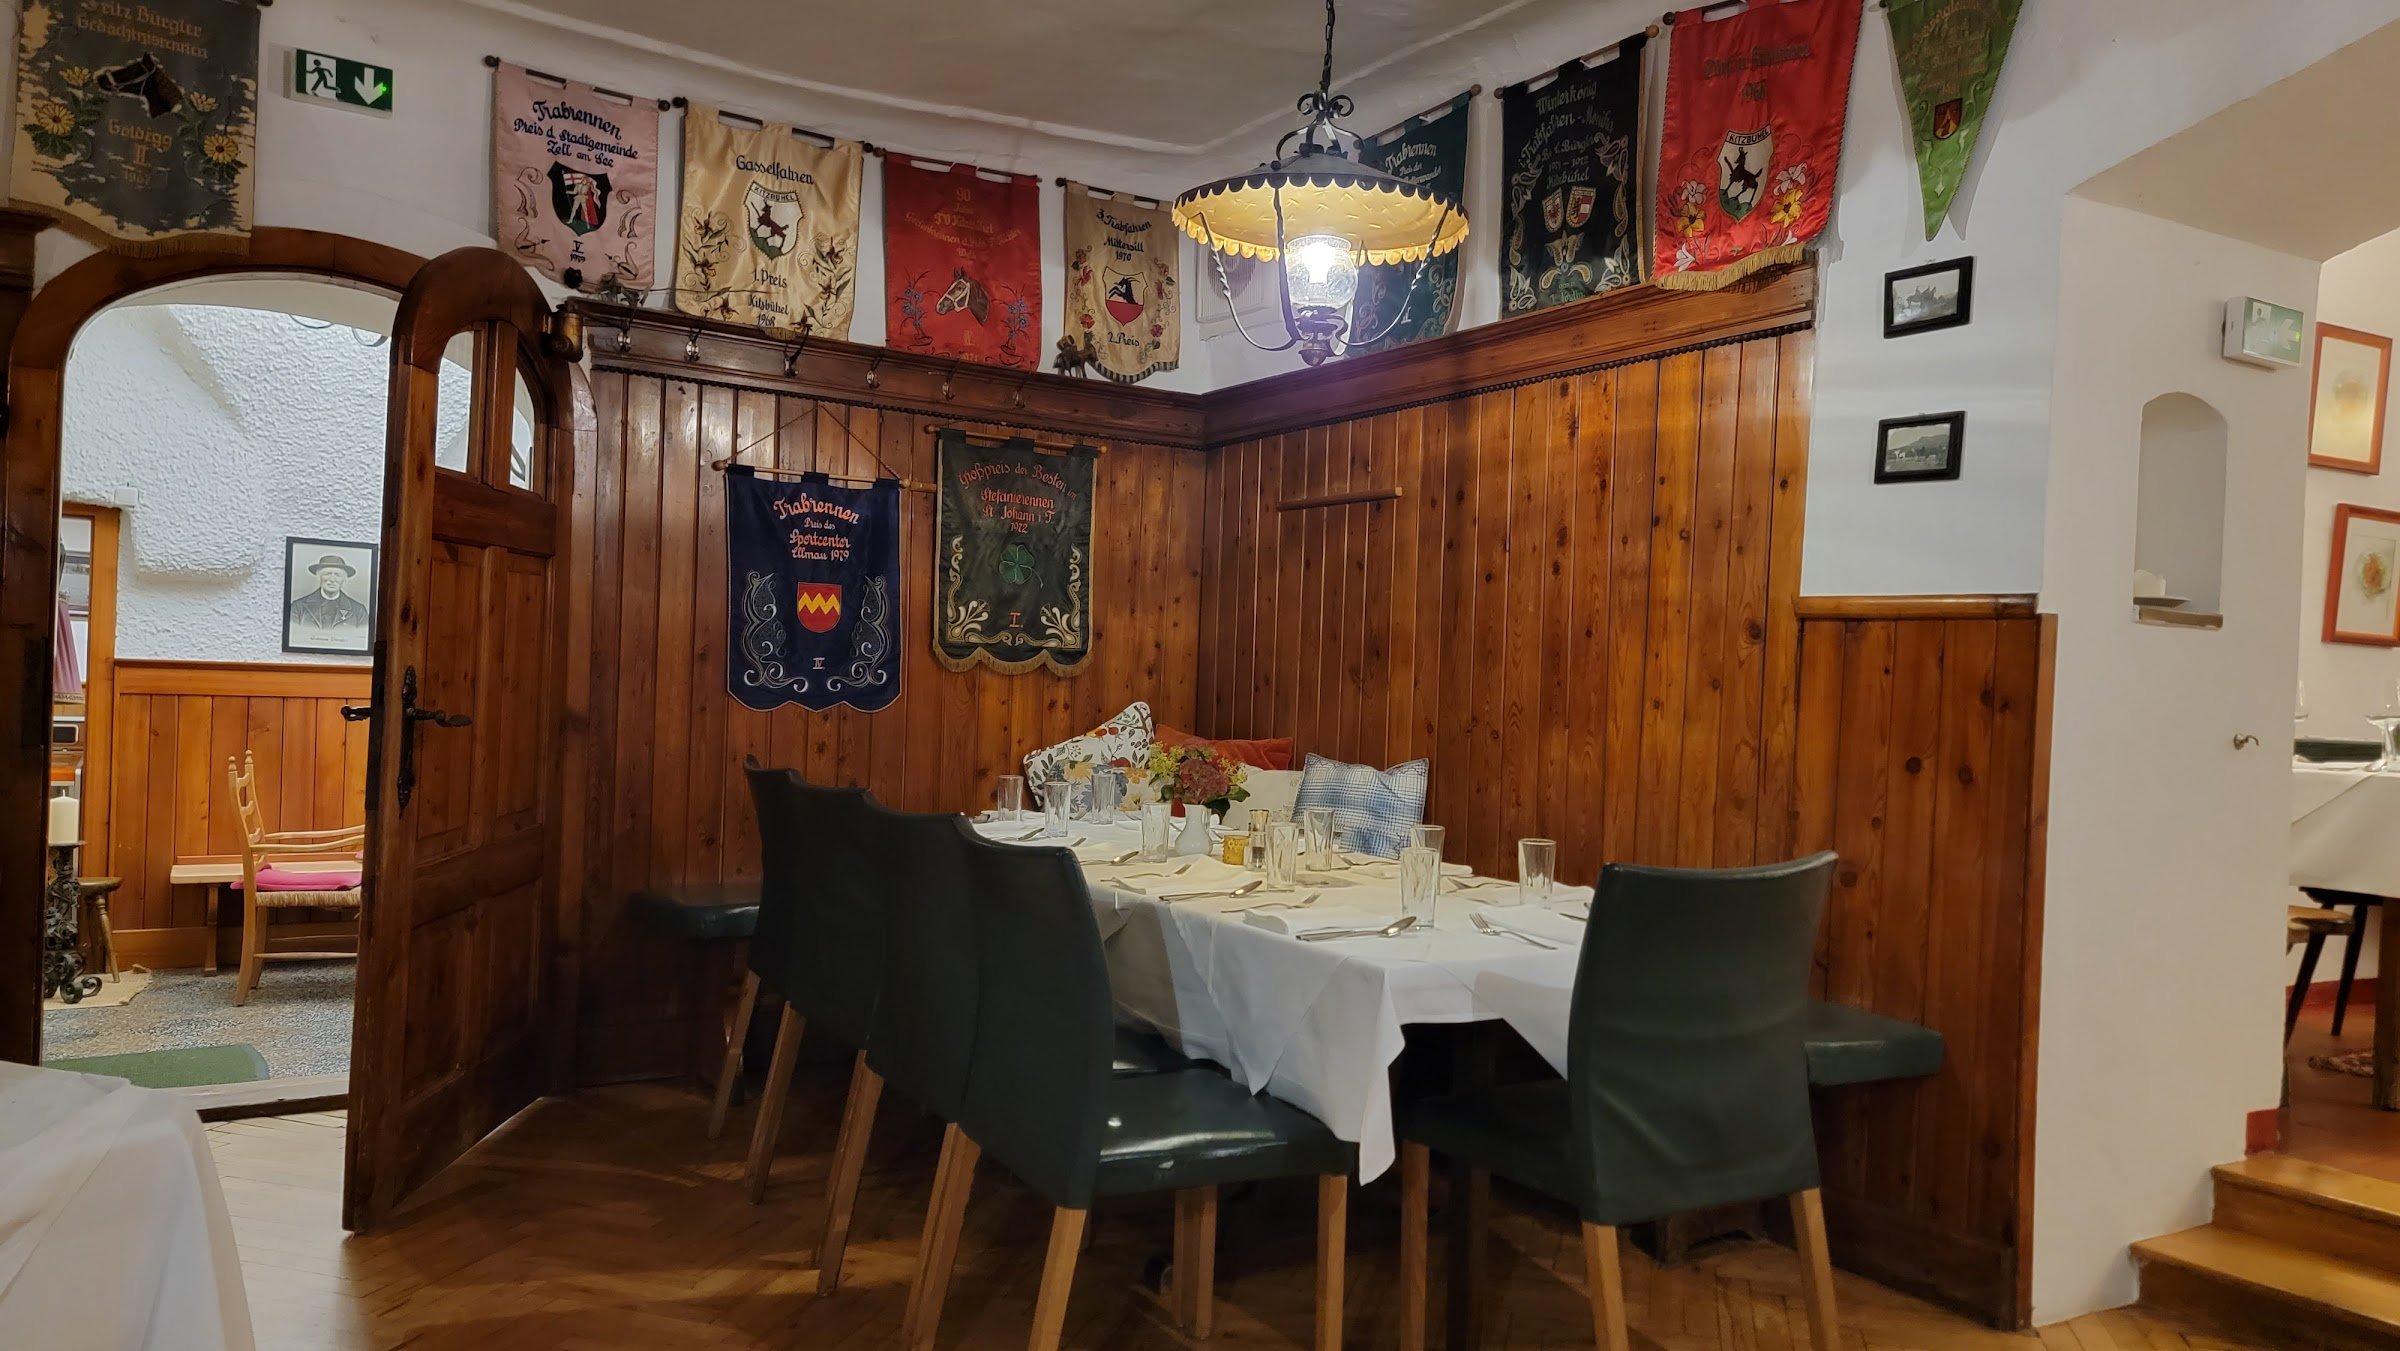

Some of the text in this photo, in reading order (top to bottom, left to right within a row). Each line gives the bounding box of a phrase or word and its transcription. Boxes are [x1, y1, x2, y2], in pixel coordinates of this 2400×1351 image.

[532, 100, 622, 140] Trabrennen
[514, 118, 543, 136] Preis
[559, 129, 638, 159] Stadtgemeinde
[547, 139, 614, 167] Zell am See
[1385, 142, 1437, 175] Trabrennen
[736, 155, 814, 185] Gasselfahren
[1104, 214, 1152, 236] Trabfahren
[1104, 236, 1144, 253] Mittersill
[1116, 251, 1132, 262] 1970
[761, 268, 787, 288] Preis
[757, 313, 776, 327] 1968
[1117, 331, 1140, 346] Preis
[959, 462, 1011, 489] Großpreis
[1014, 462, 1028, 475] der
[1032, 464, 1067, 492] Besten
[773, 492, 860, 524] Trabrennen
[981, 487, 1054, 509] Stefanierennen
[804, 516, 836, 530] Preis des
[1000, 505, 1035, 522] Johann
[1010, 521, 1028, 534] 1972
[789, 528, 851, 548] Sportcenter
[791, 545, 850, 562] Ellmau 1979
[812, 657, 826, 670] IV
